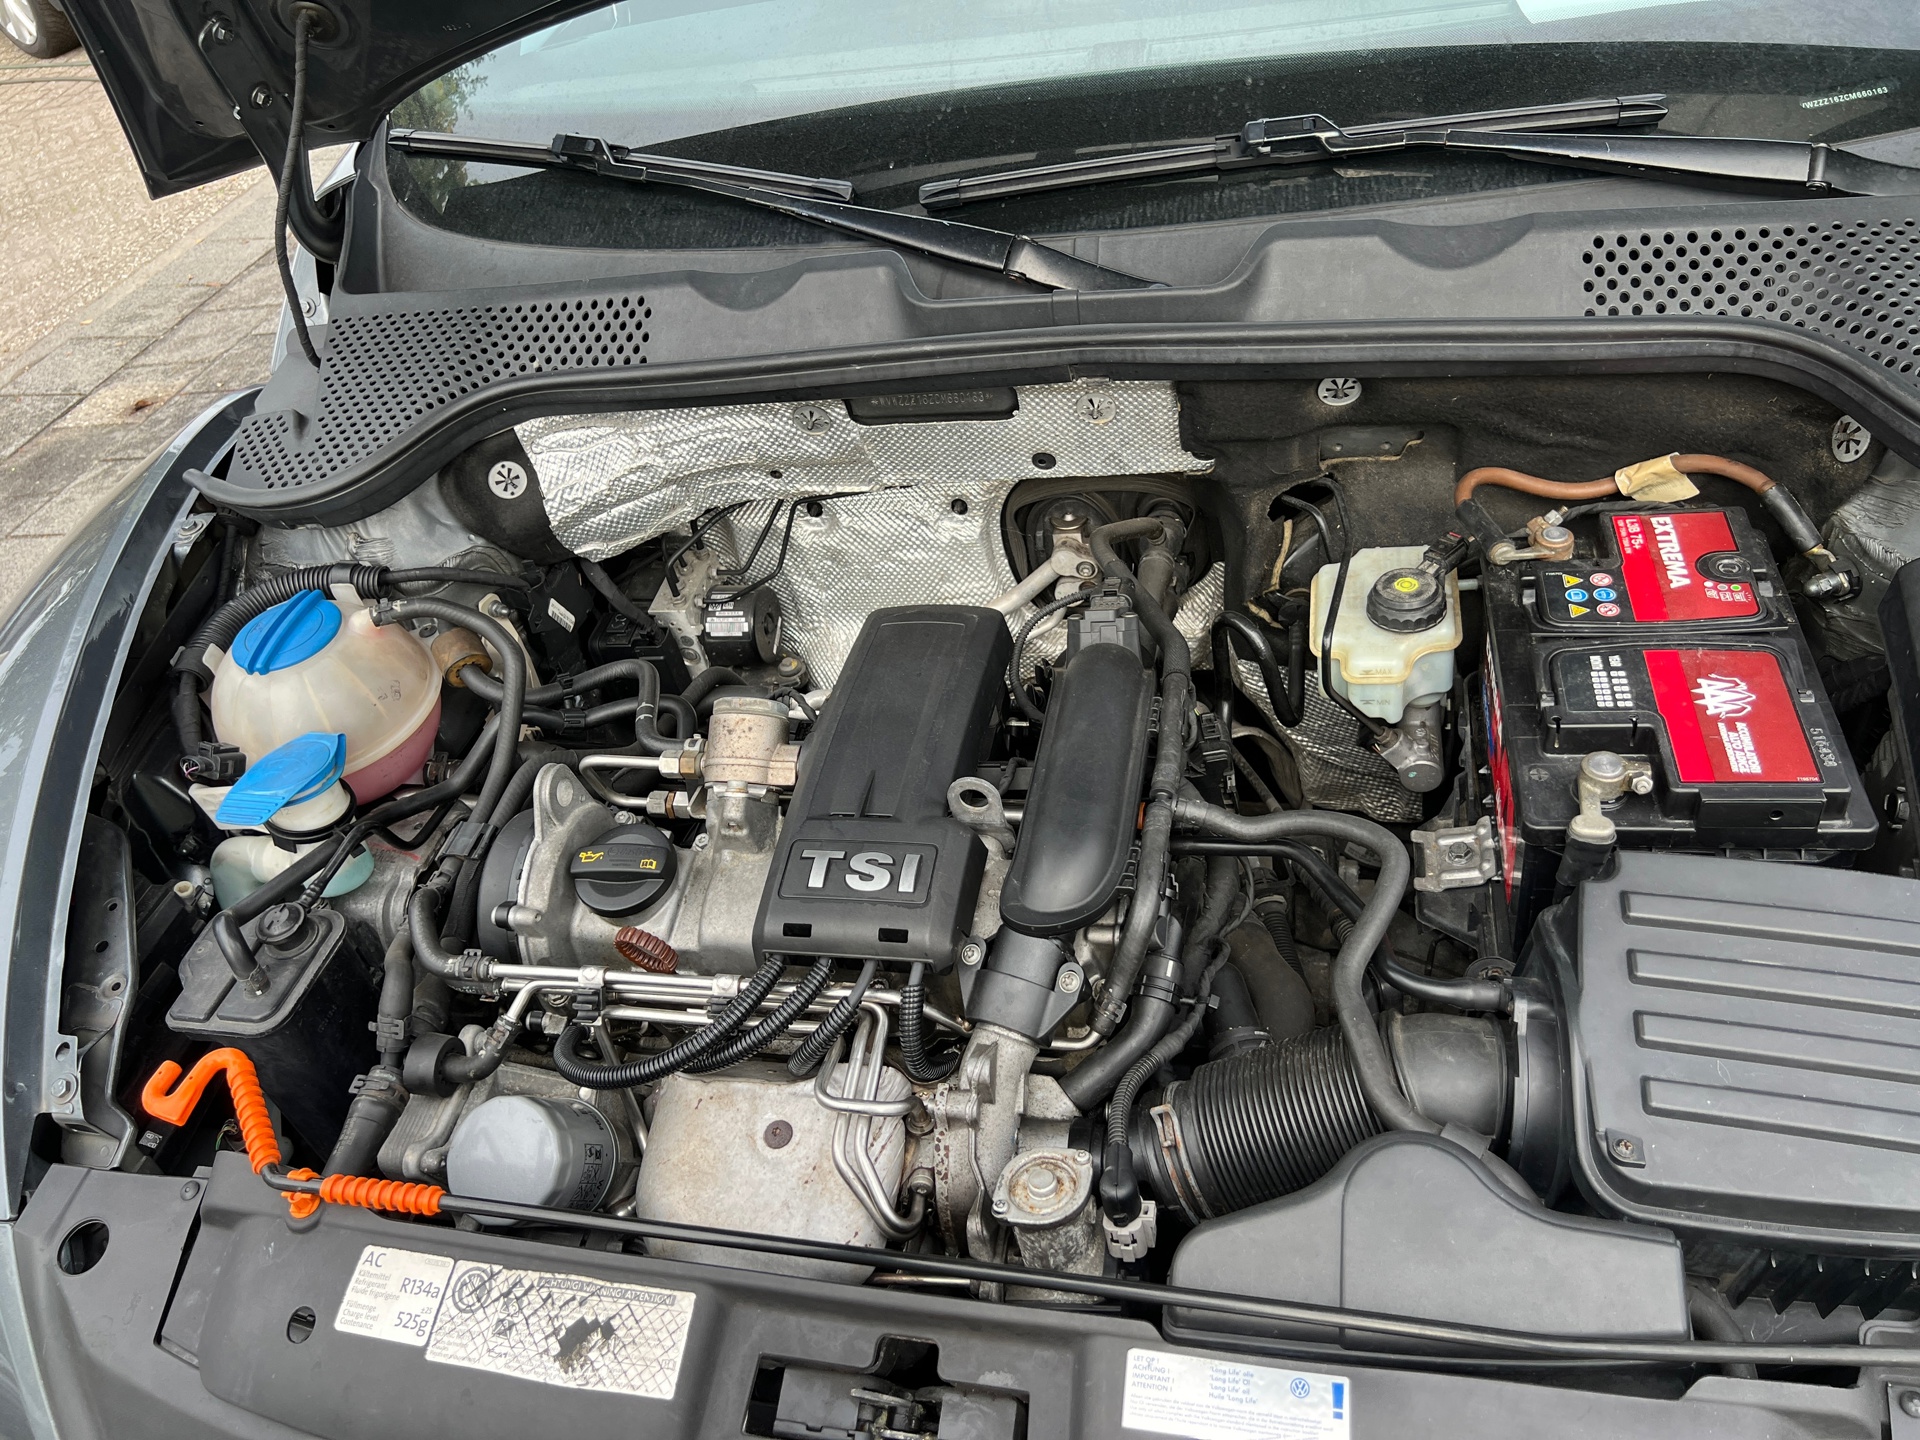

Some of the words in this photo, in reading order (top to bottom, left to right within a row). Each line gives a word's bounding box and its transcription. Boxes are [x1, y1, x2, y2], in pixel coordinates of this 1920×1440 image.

[1650, 516, 1691, 589] EXTREMA
[802, 850, 921, 892] TSI
[362, 1251, 386, 1268] AC
[358, 1269, 392, 1281] Kältemittel
[355, 1277, 387, 1290] Refrigerant
[399, 1277, 440, 1299] R134a
[351, 1285, 369, 1296] Fluide
[369, 1289, 400, 1302] frigorigène
[346, 1300, 377, 1313] Füllmenge
[343, 1309, 363, 1320] Charge
[364, 1313, 380, 1322] level
[340, 1317, 374, 1330] Contenance
[394, 1311, 429, 1337] 525g
[1133, 1363, 1166, 1374] ACHTUNG
[1132, 1372, 1171, 1384] IMPORTANT
[1131, 1380, 1169, 1392] ATTENTION
